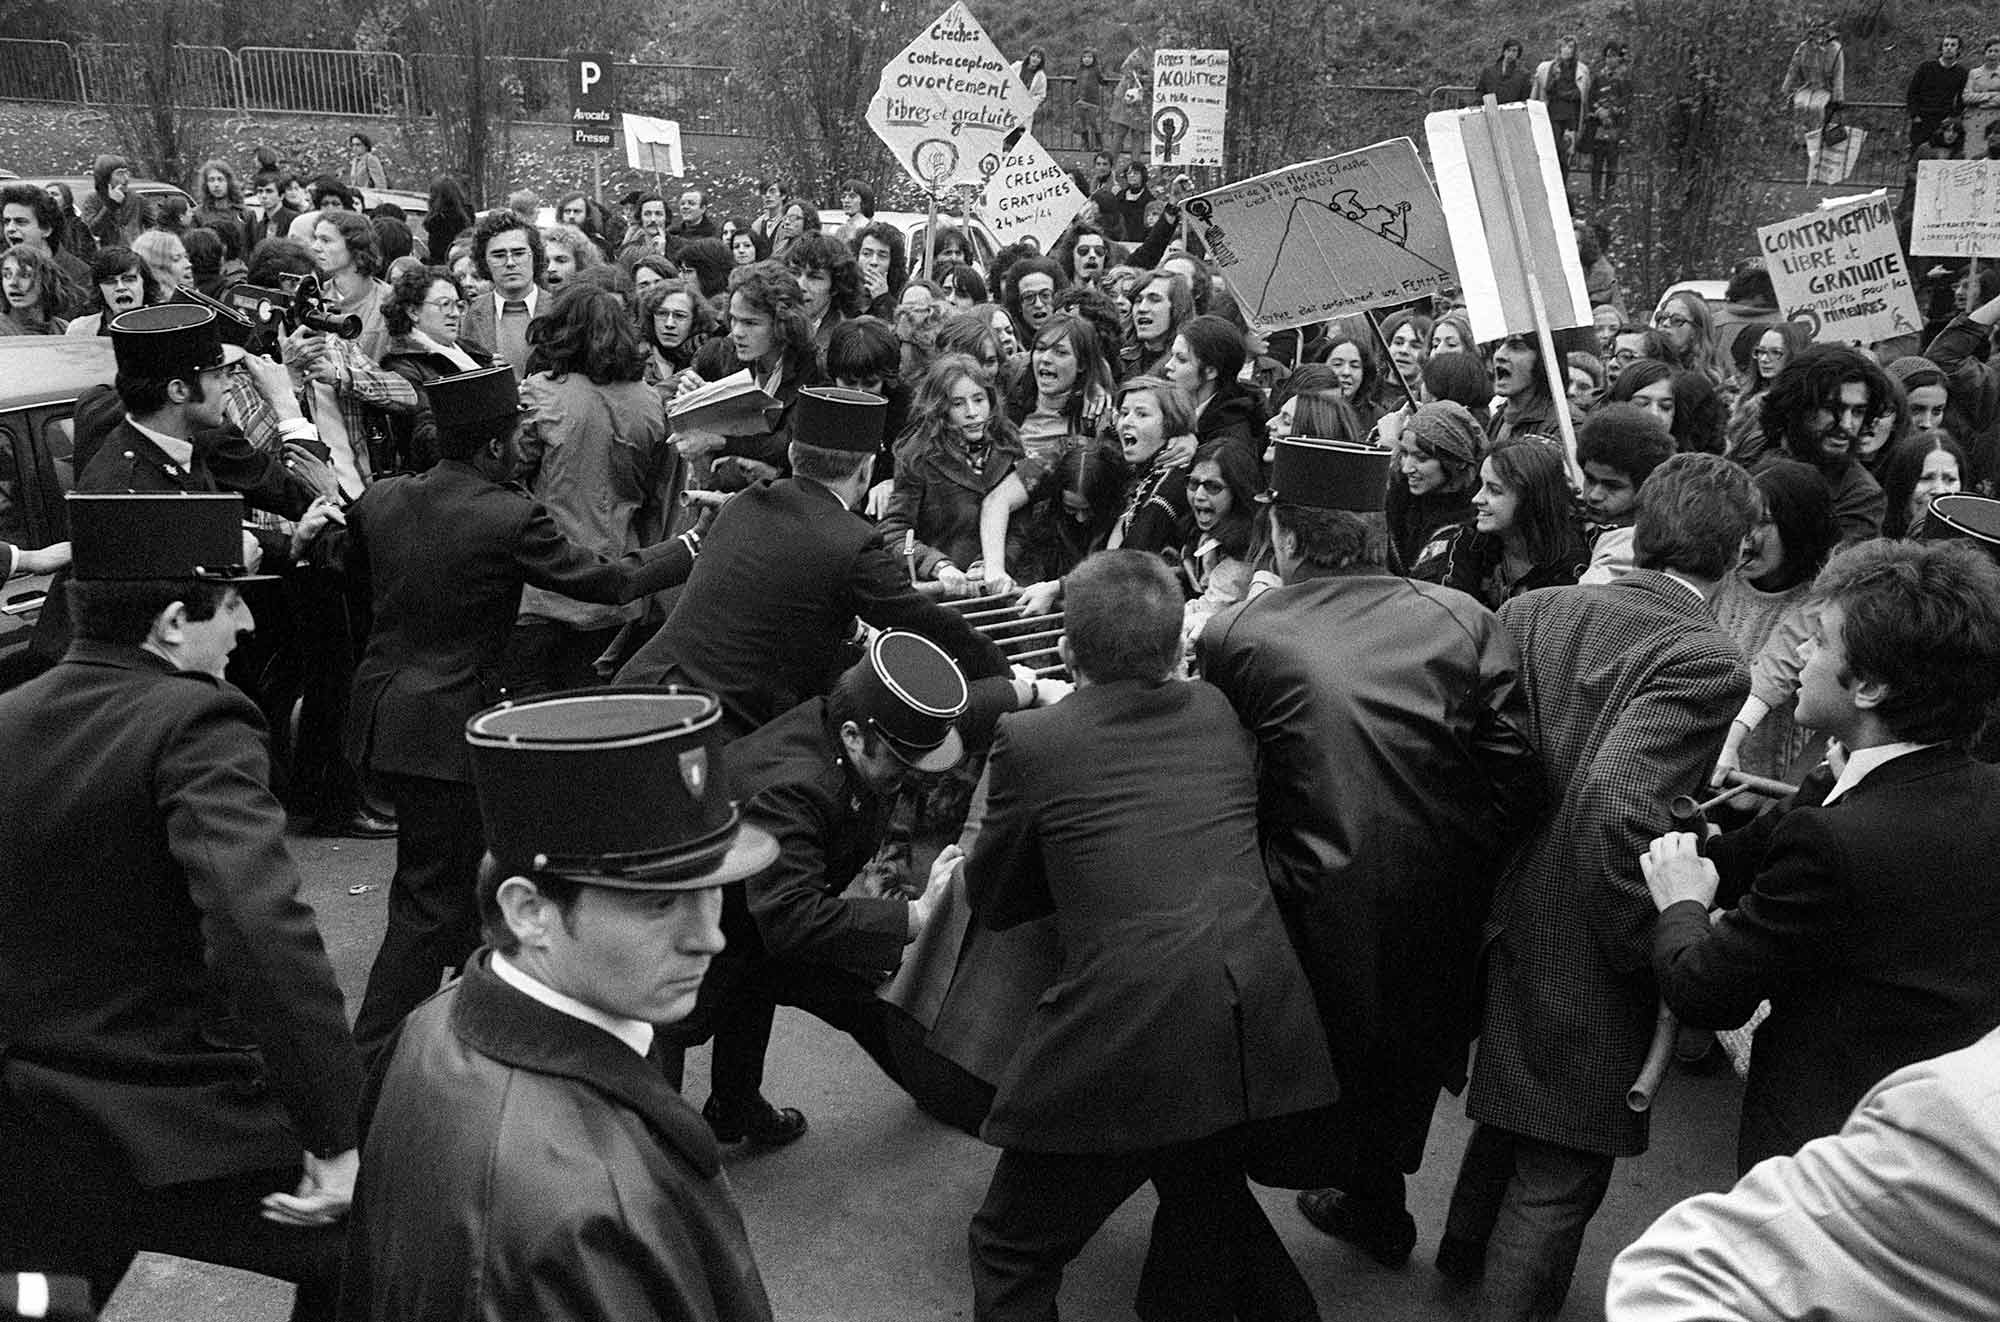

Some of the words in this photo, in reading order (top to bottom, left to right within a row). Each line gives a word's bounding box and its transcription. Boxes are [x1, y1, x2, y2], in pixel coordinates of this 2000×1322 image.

[908, 51, 1004, 73] contraception
[581, 61, 601, 94] P
[897, 74, 1012, 100] avortement
[573, 108, 610, 121] Avocats
[886, 97, 930, 122] libres
[932, 108, 947, 121] et
[951, 105, 1018, 136] gratuits
[576, 130, 610, 143] Presse
[1006, 154, 1035, 168] DES
[1005, 165, 1061, 189] CRECHES
[1764, 199, 1893, 254] CONTRACEPTION
[1401, 273, 1451, 293] FEMME
[1809, 252, 1900, 294] GRATUITE
[1797, 294, 1856, 315] compris
[1861, 284, 1889, 300] pour
[1892, 278, 1908, 291] les
